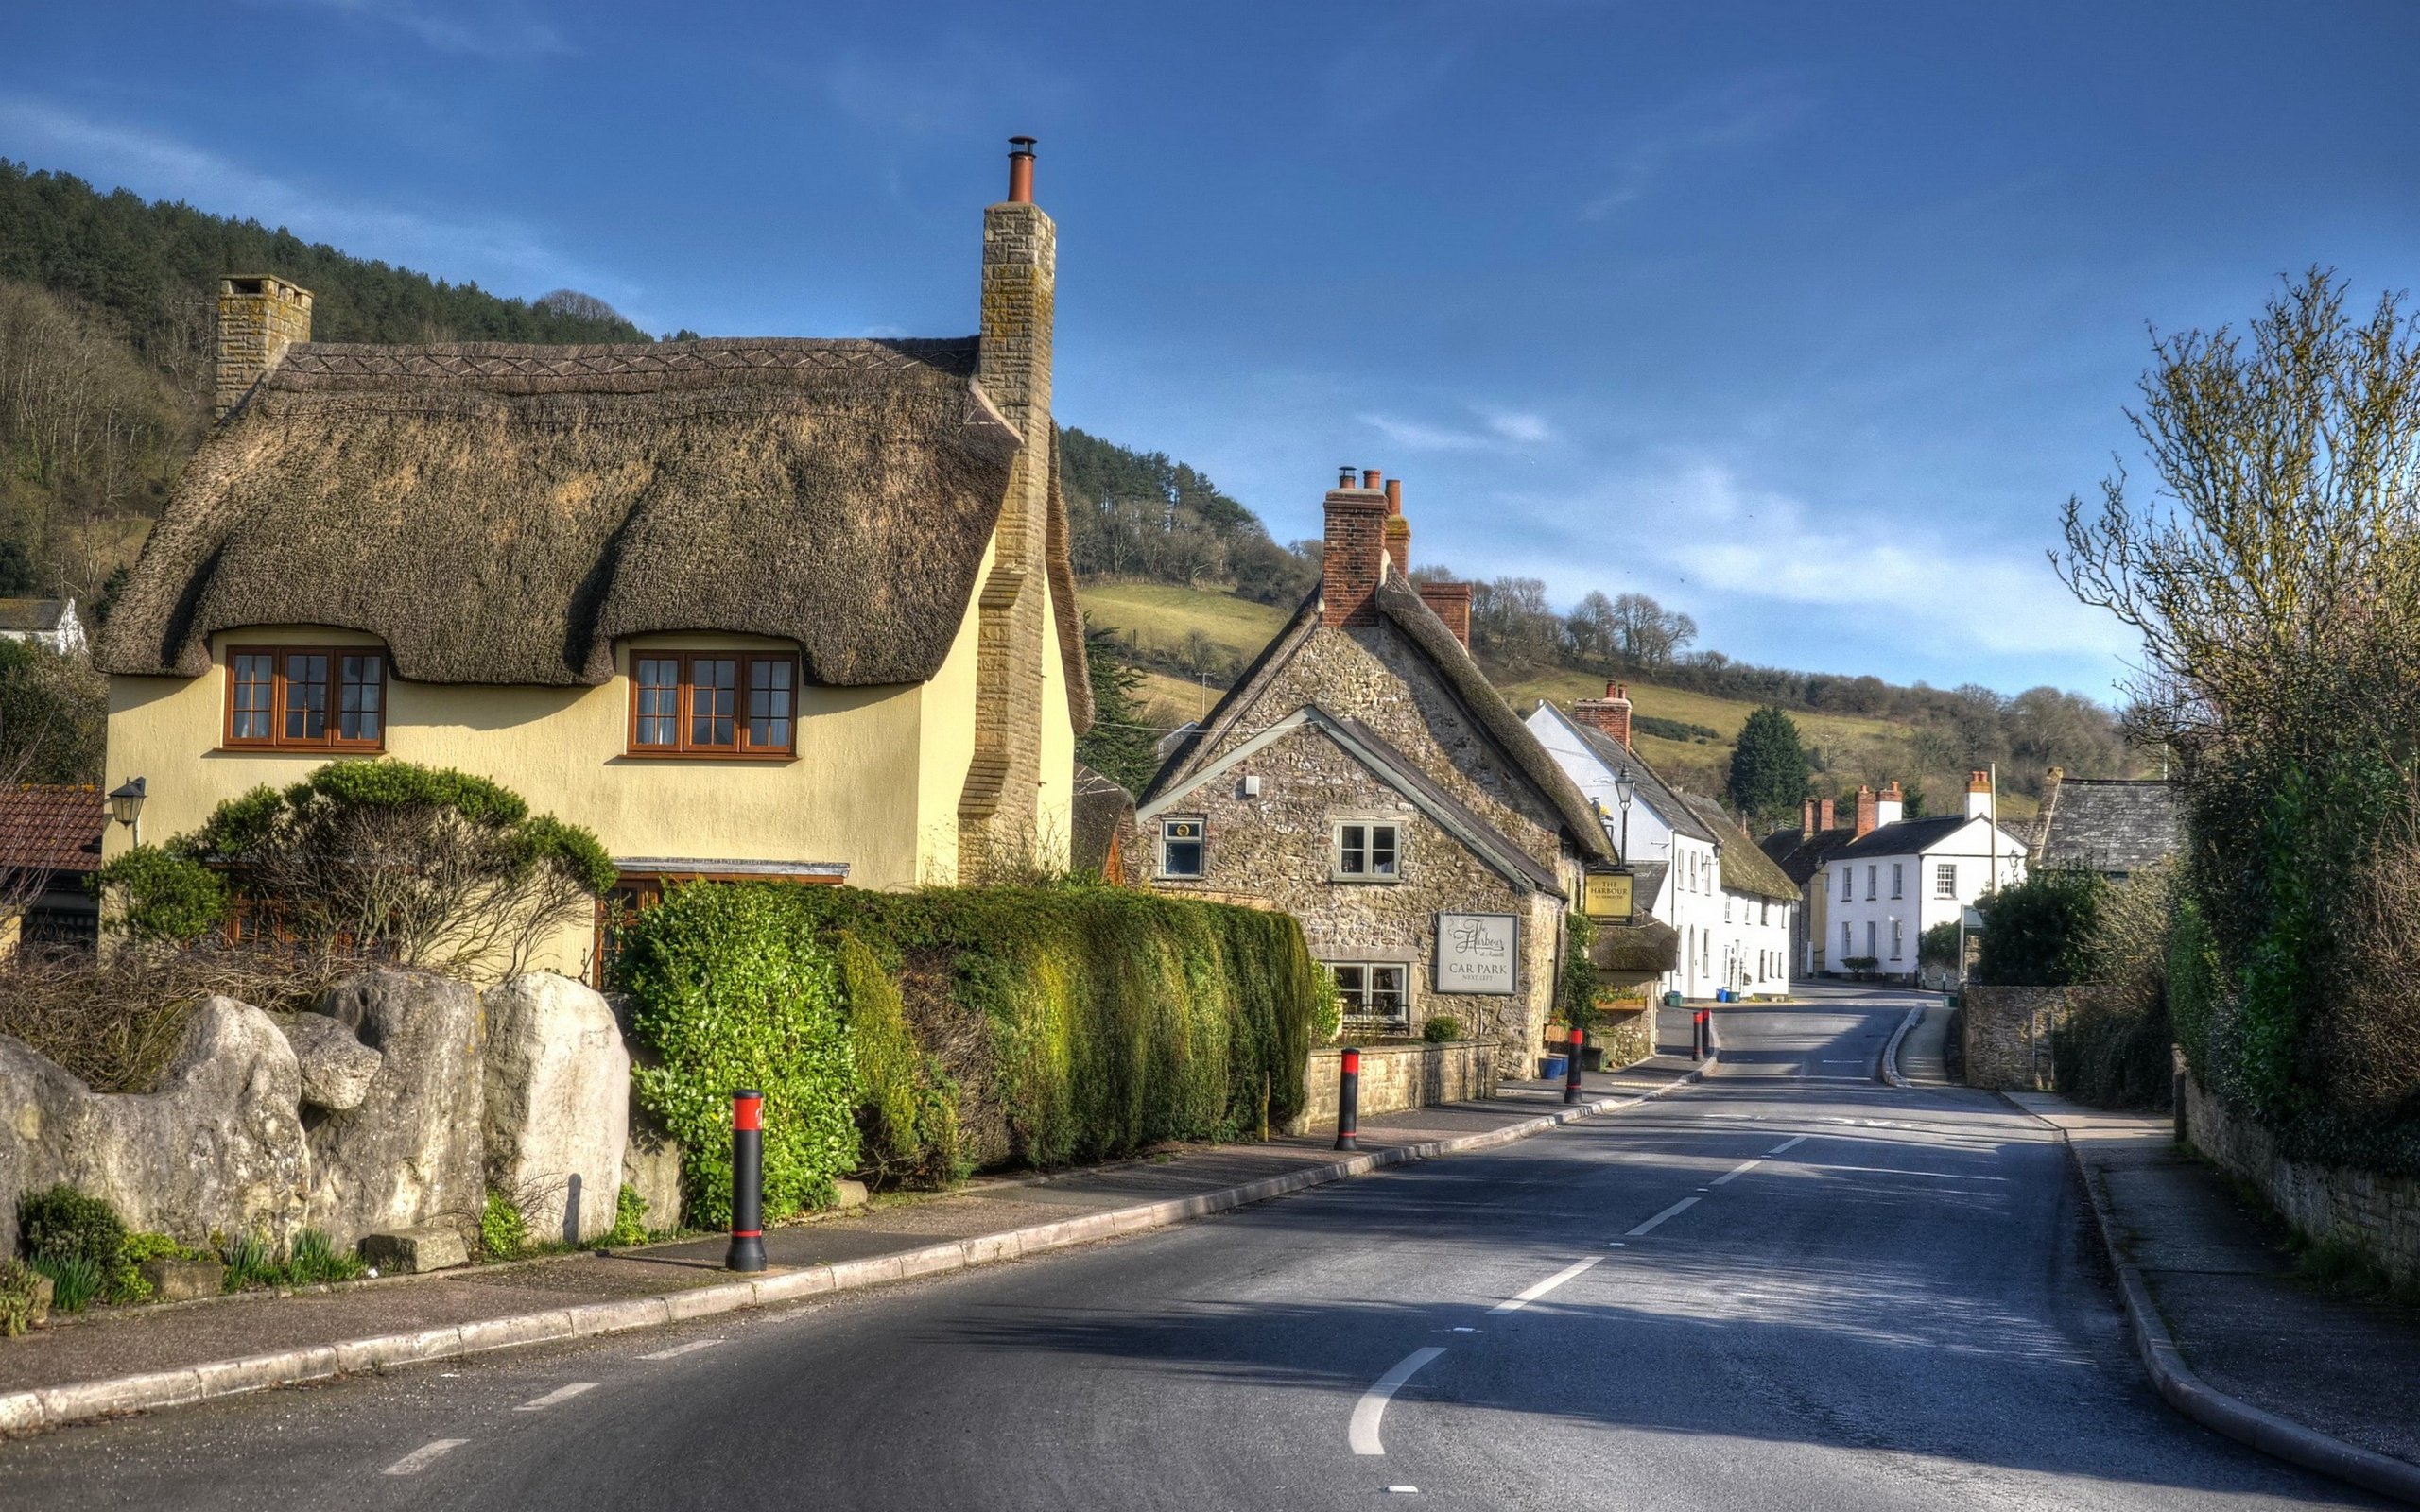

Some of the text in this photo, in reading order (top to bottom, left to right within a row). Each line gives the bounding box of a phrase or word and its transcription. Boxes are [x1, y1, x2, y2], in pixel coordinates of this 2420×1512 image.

[1453, 929, 1504, 954] Harbour
[1449, 962, 1508, 974] CAR PARK
